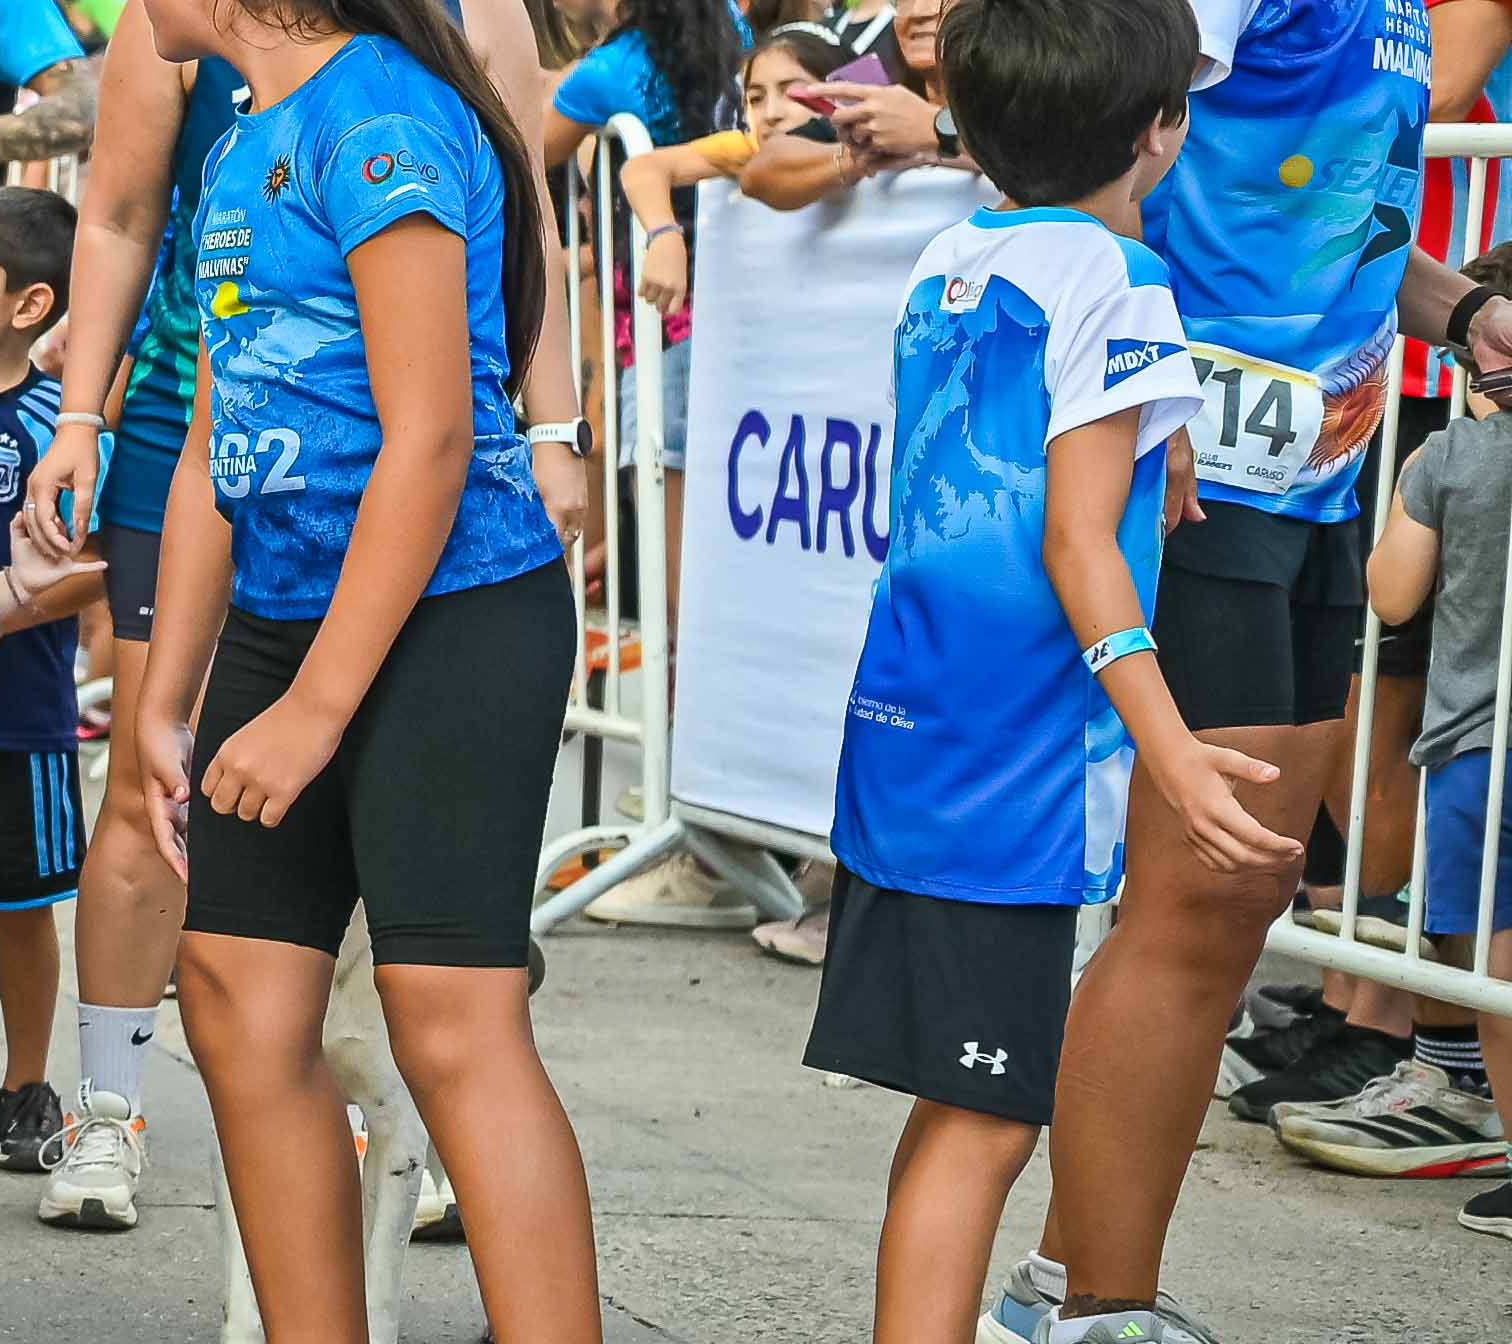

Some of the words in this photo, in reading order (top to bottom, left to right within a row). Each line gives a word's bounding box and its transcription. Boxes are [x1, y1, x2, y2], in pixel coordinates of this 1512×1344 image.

[1107, 340, 1160, 374] MDXT
[209, 427, 306, 499] 82
[210, 454, 257, 476] NTINA
[1246, 465, 1284, 481] CARUSO
